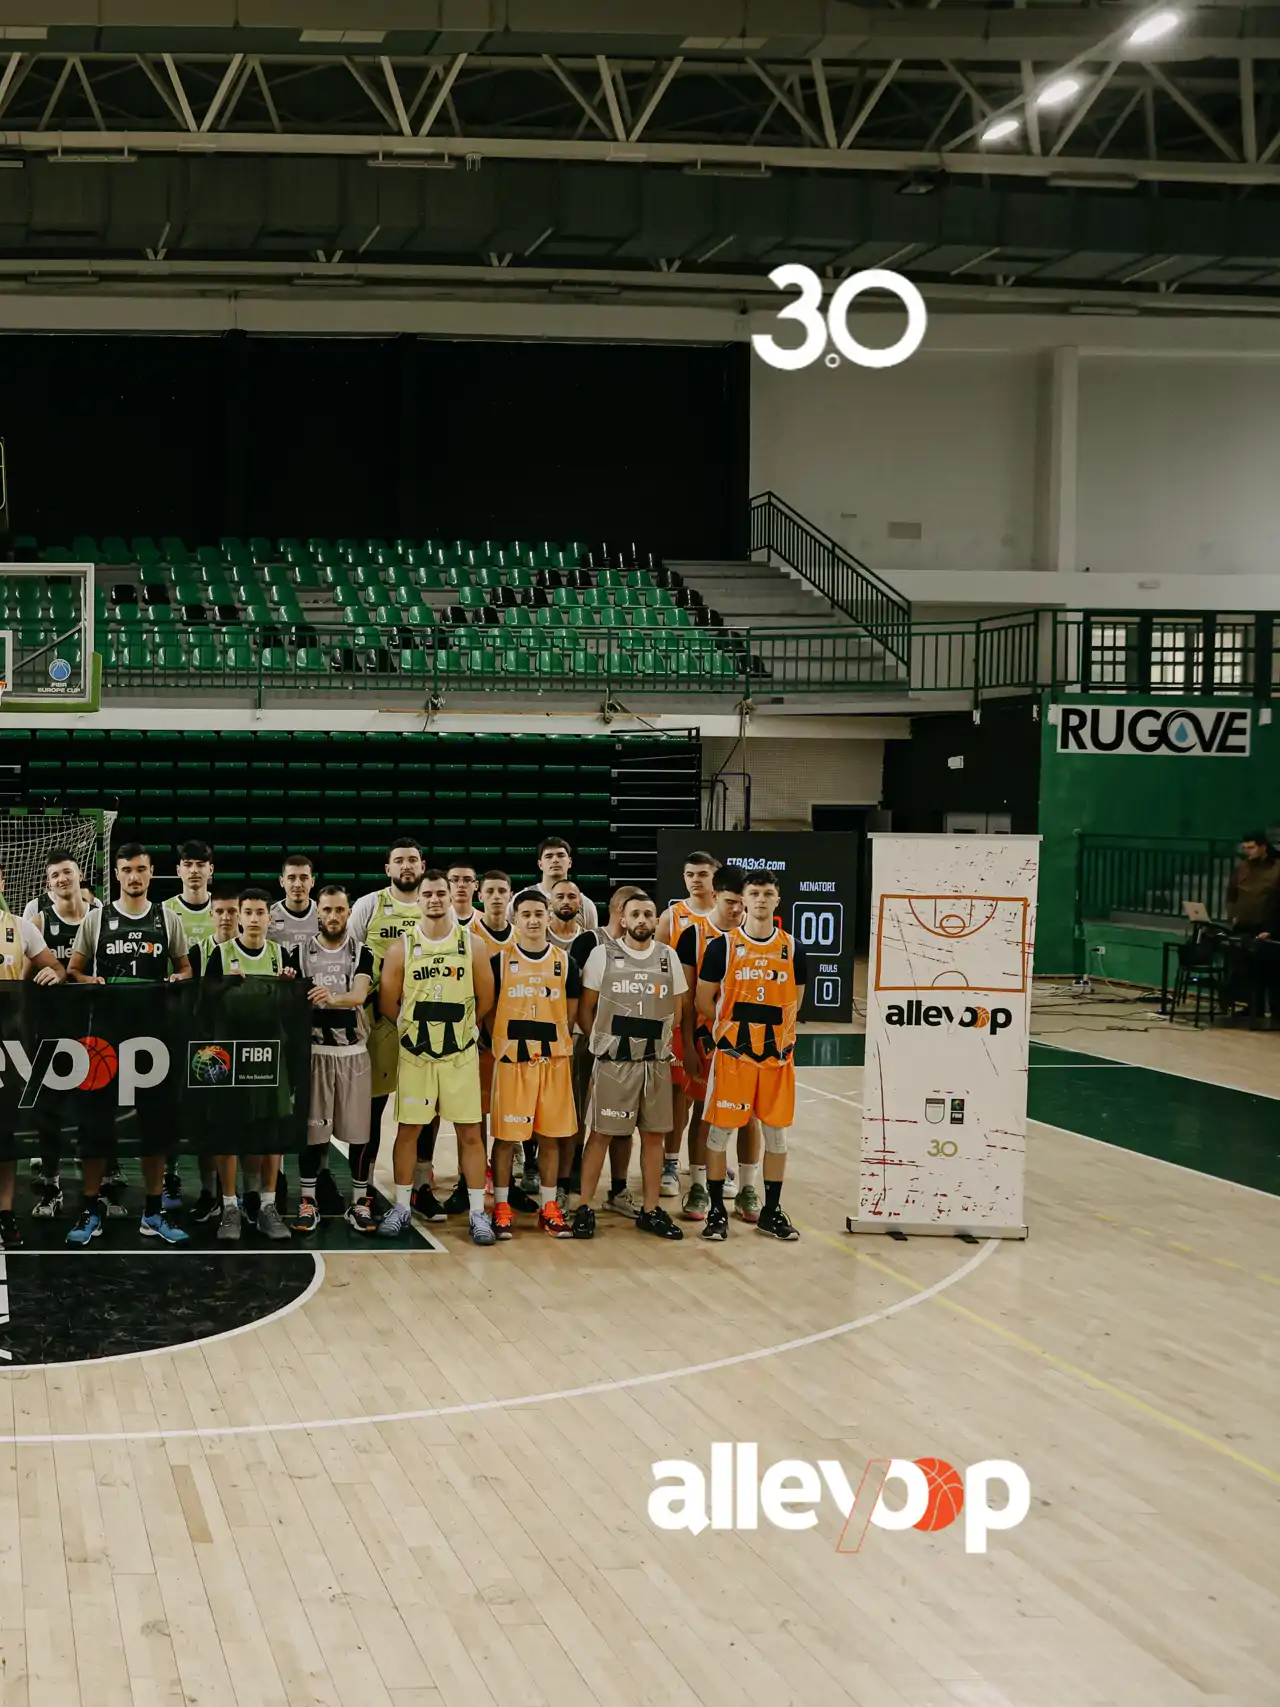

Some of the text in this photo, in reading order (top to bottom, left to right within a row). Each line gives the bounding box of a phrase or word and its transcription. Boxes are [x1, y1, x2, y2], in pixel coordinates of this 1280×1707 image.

[1060, 708, 1248, 754] RUGOVE
[799, 881, 836, 892] MINATORI
[800, 911, 835, 946] 00
[130, 960, 137, 976] 1
[819, 964, 838, 973] FOULS
[434, 983, 443, 1001] 2
[755, 986, 765, 1002] 3
[823, 981, 833, 1001] 0
[530, 1004, 537, 1019] 1
[636, 1001, 644, 1016] 1
[241, 1047, 272, 1062] FIBA
